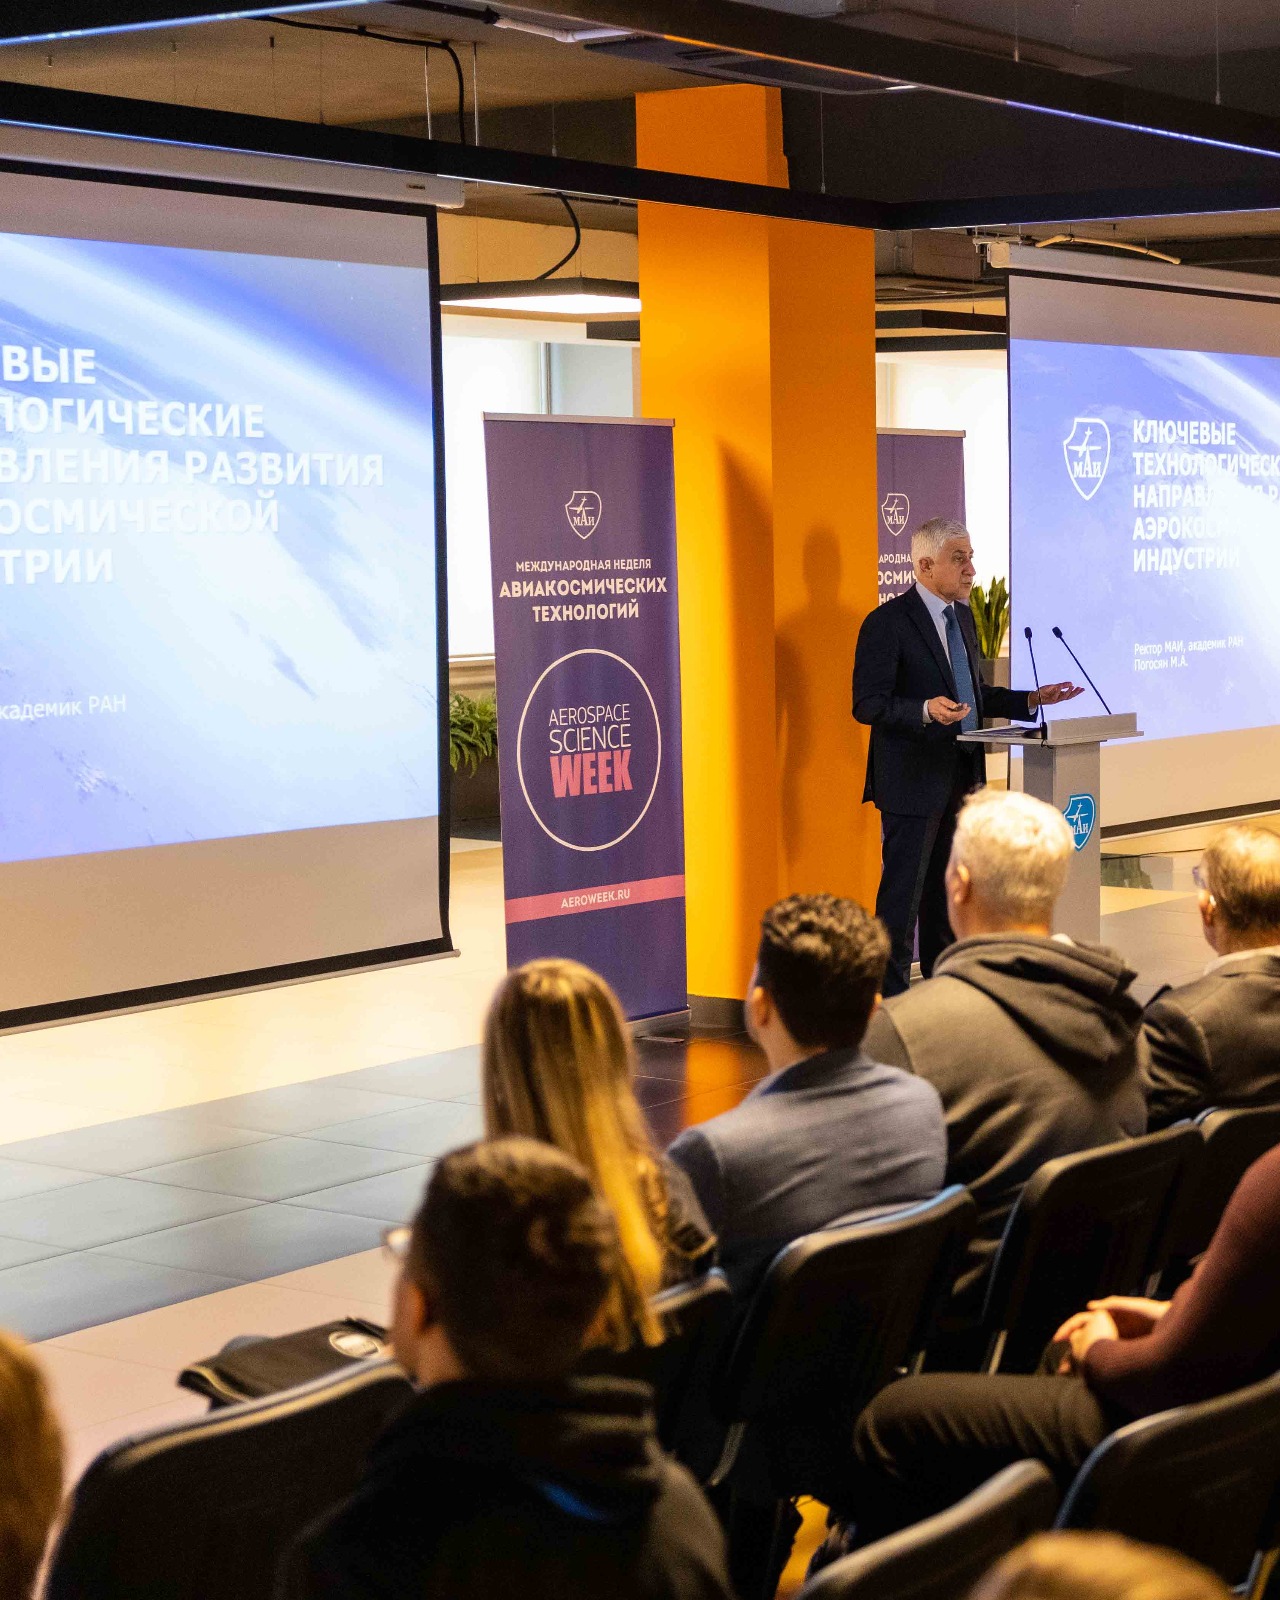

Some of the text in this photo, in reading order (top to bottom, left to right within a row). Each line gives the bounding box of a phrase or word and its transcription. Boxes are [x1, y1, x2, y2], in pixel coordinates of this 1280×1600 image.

[2, 344, 97, 385] ВЫЕ
[1133, 419, 1237, 446] КЛЮЧЕВЫЕ
[185, 450, 384, 487] РАЗВИТИЯ
[1133, 484, 1264, 508] НАПРАВЛИЯ
[515, 558, 652, 573] МЕЖДУНАРОДНАЯ НЕДЕЛЯ
[879, 553, 914, 564] АРОДНА
[1133, 548, 1240, 576] ИНДУСТРИИ
[499, 576, 668, 598] АВИАКОСМИЧЕСКИХ
[532, 598, 640, 623] ТЕХНОЛОГИЙ
[1134, 636, 1244, 656] Ректор МАИ, академик РАН
[1134, 655, 1188, 671] Погосян М.А.
[88, 694, 126, 714] РАН
[549, 703, 631, 727] AEROSPACE
[549, 723, 632, 754] SCIENCE
[550, 749, 634, 799] WEEK
[561, 888, 631, 909] AEROWEEK.RU
